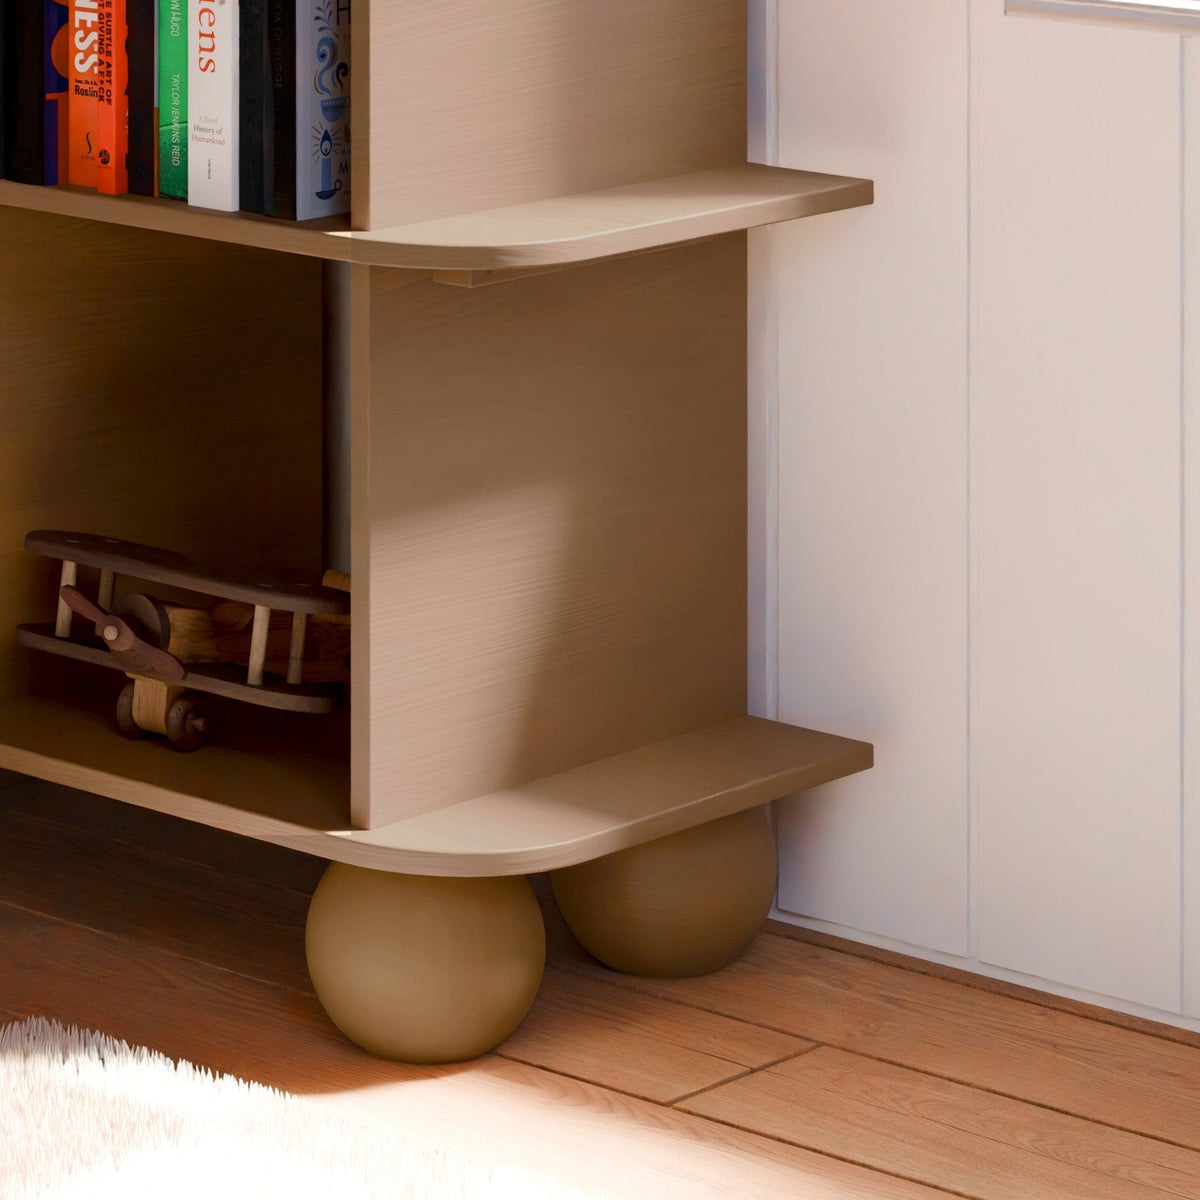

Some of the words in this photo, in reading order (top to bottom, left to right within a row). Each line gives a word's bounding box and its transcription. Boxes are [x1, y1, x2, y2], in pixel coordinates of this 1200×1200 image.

[98, 12, 106, 55] GIVING
[105, 12, 113, 57] SUBTLE
[98, 58, 106, 68] A
[105, 60, 113, 85] ART
[105, 89, 113, 106] OF
[171, 73, 180, 106] TAYLOR
[171, 106, 180, 143] JENKINS
[193, 124, 215, 136] History
[215, 127, 223, 135] of
[191, 134, 226, 146] Humankind
[171, 144, 180, 167] REID
